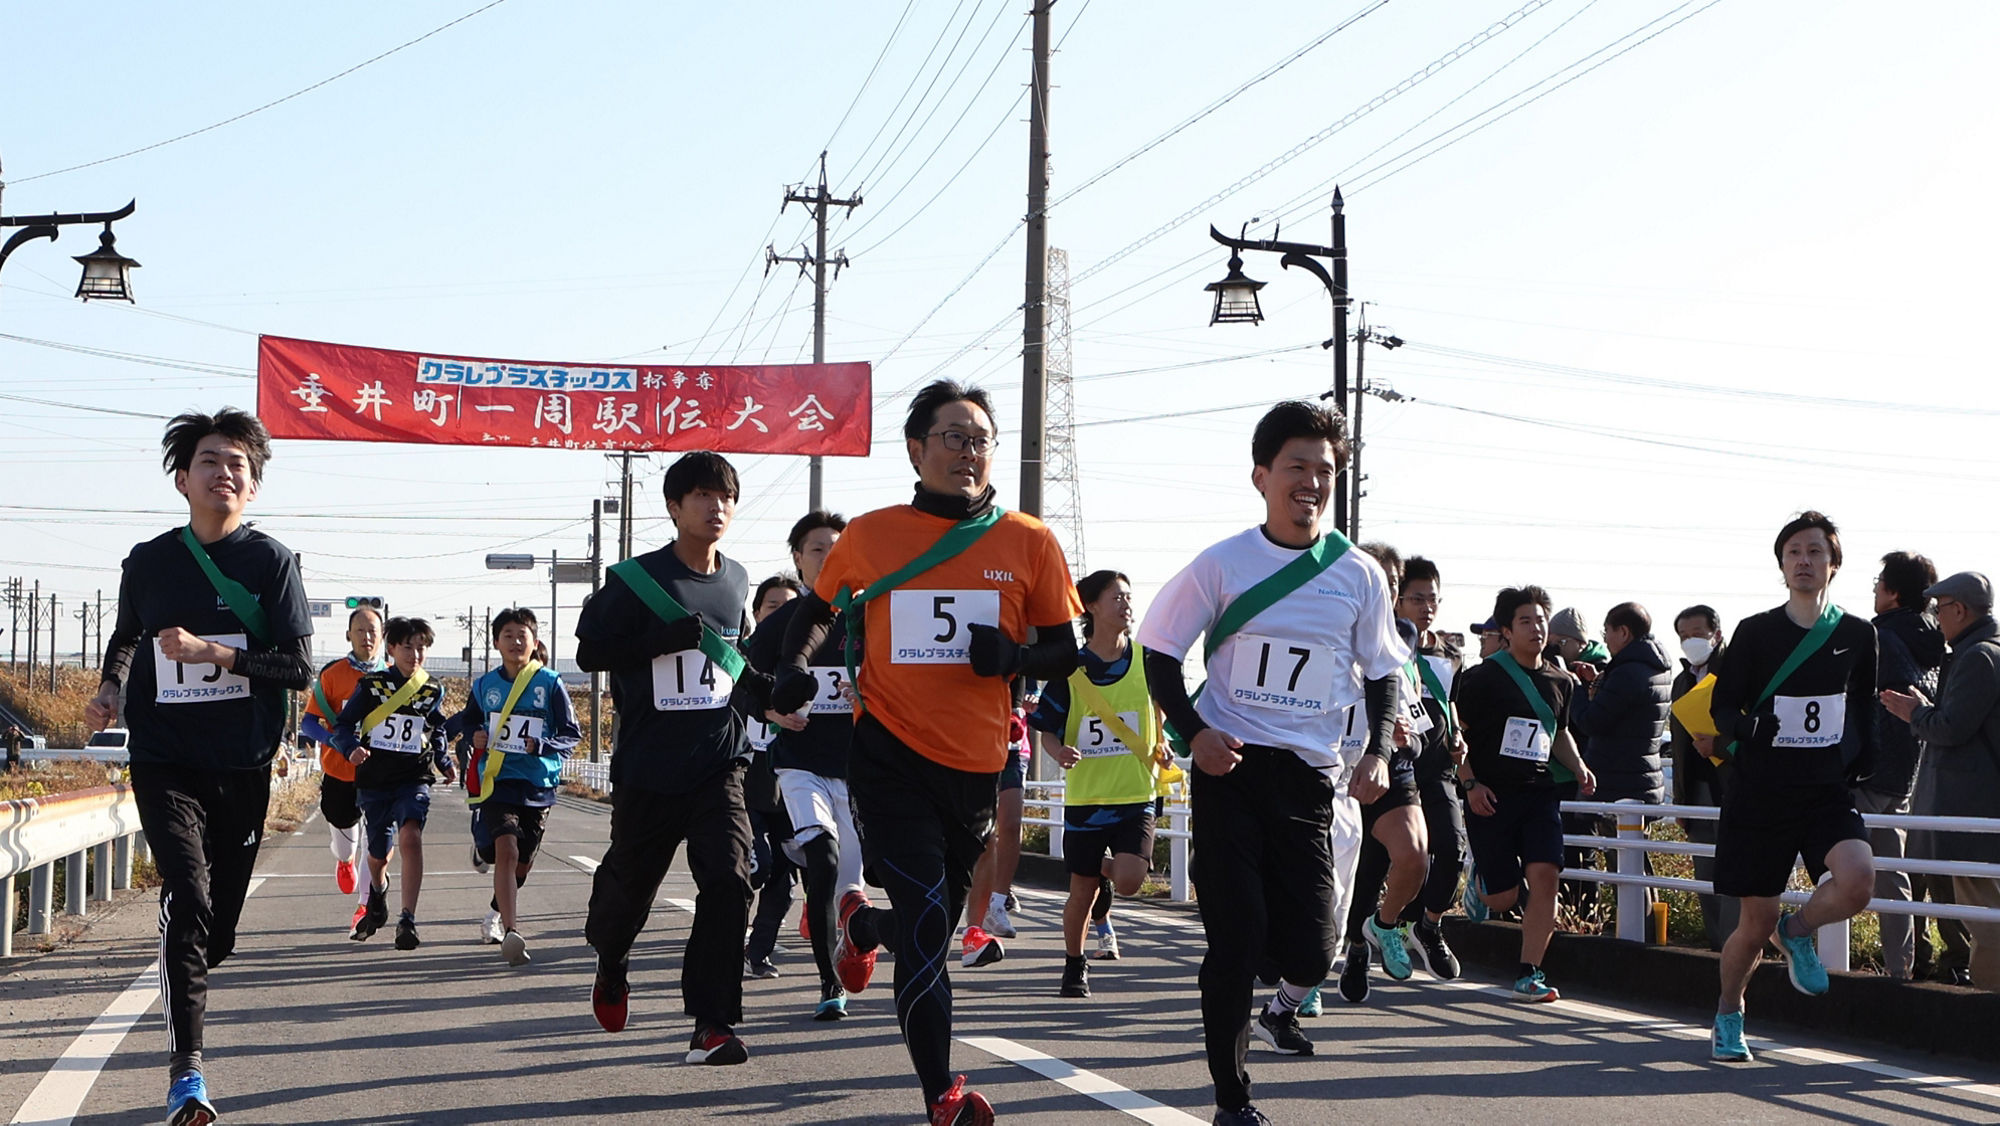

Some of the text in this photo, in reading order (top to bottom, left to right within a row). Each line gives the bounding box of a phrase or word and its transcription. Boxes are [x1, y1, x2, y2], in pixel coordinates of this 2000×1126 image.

[422, 361, 714, 391] クラレプラスチックス 杯争奪
[290, 372, 835, 435] 垂井町一周駅伝大会
[984, 569, 1014, 582] LIXIL
[933, 596, 957, 643] 5
[675, 655, 716, 693] 14
[1256, 642, 1310, 692] 17
[162, 684, 243, 699] クラレプラスチックス
[533, 686, 546, 709] 3
[1234, 689, 1321, 711] クラレプラスチックス
[383, 716, 413, 742] 58
[1804, 701, 1820, 733] 8
[500, 717, 531, 748] 54
[1527, 723, 1538, 749] 7
